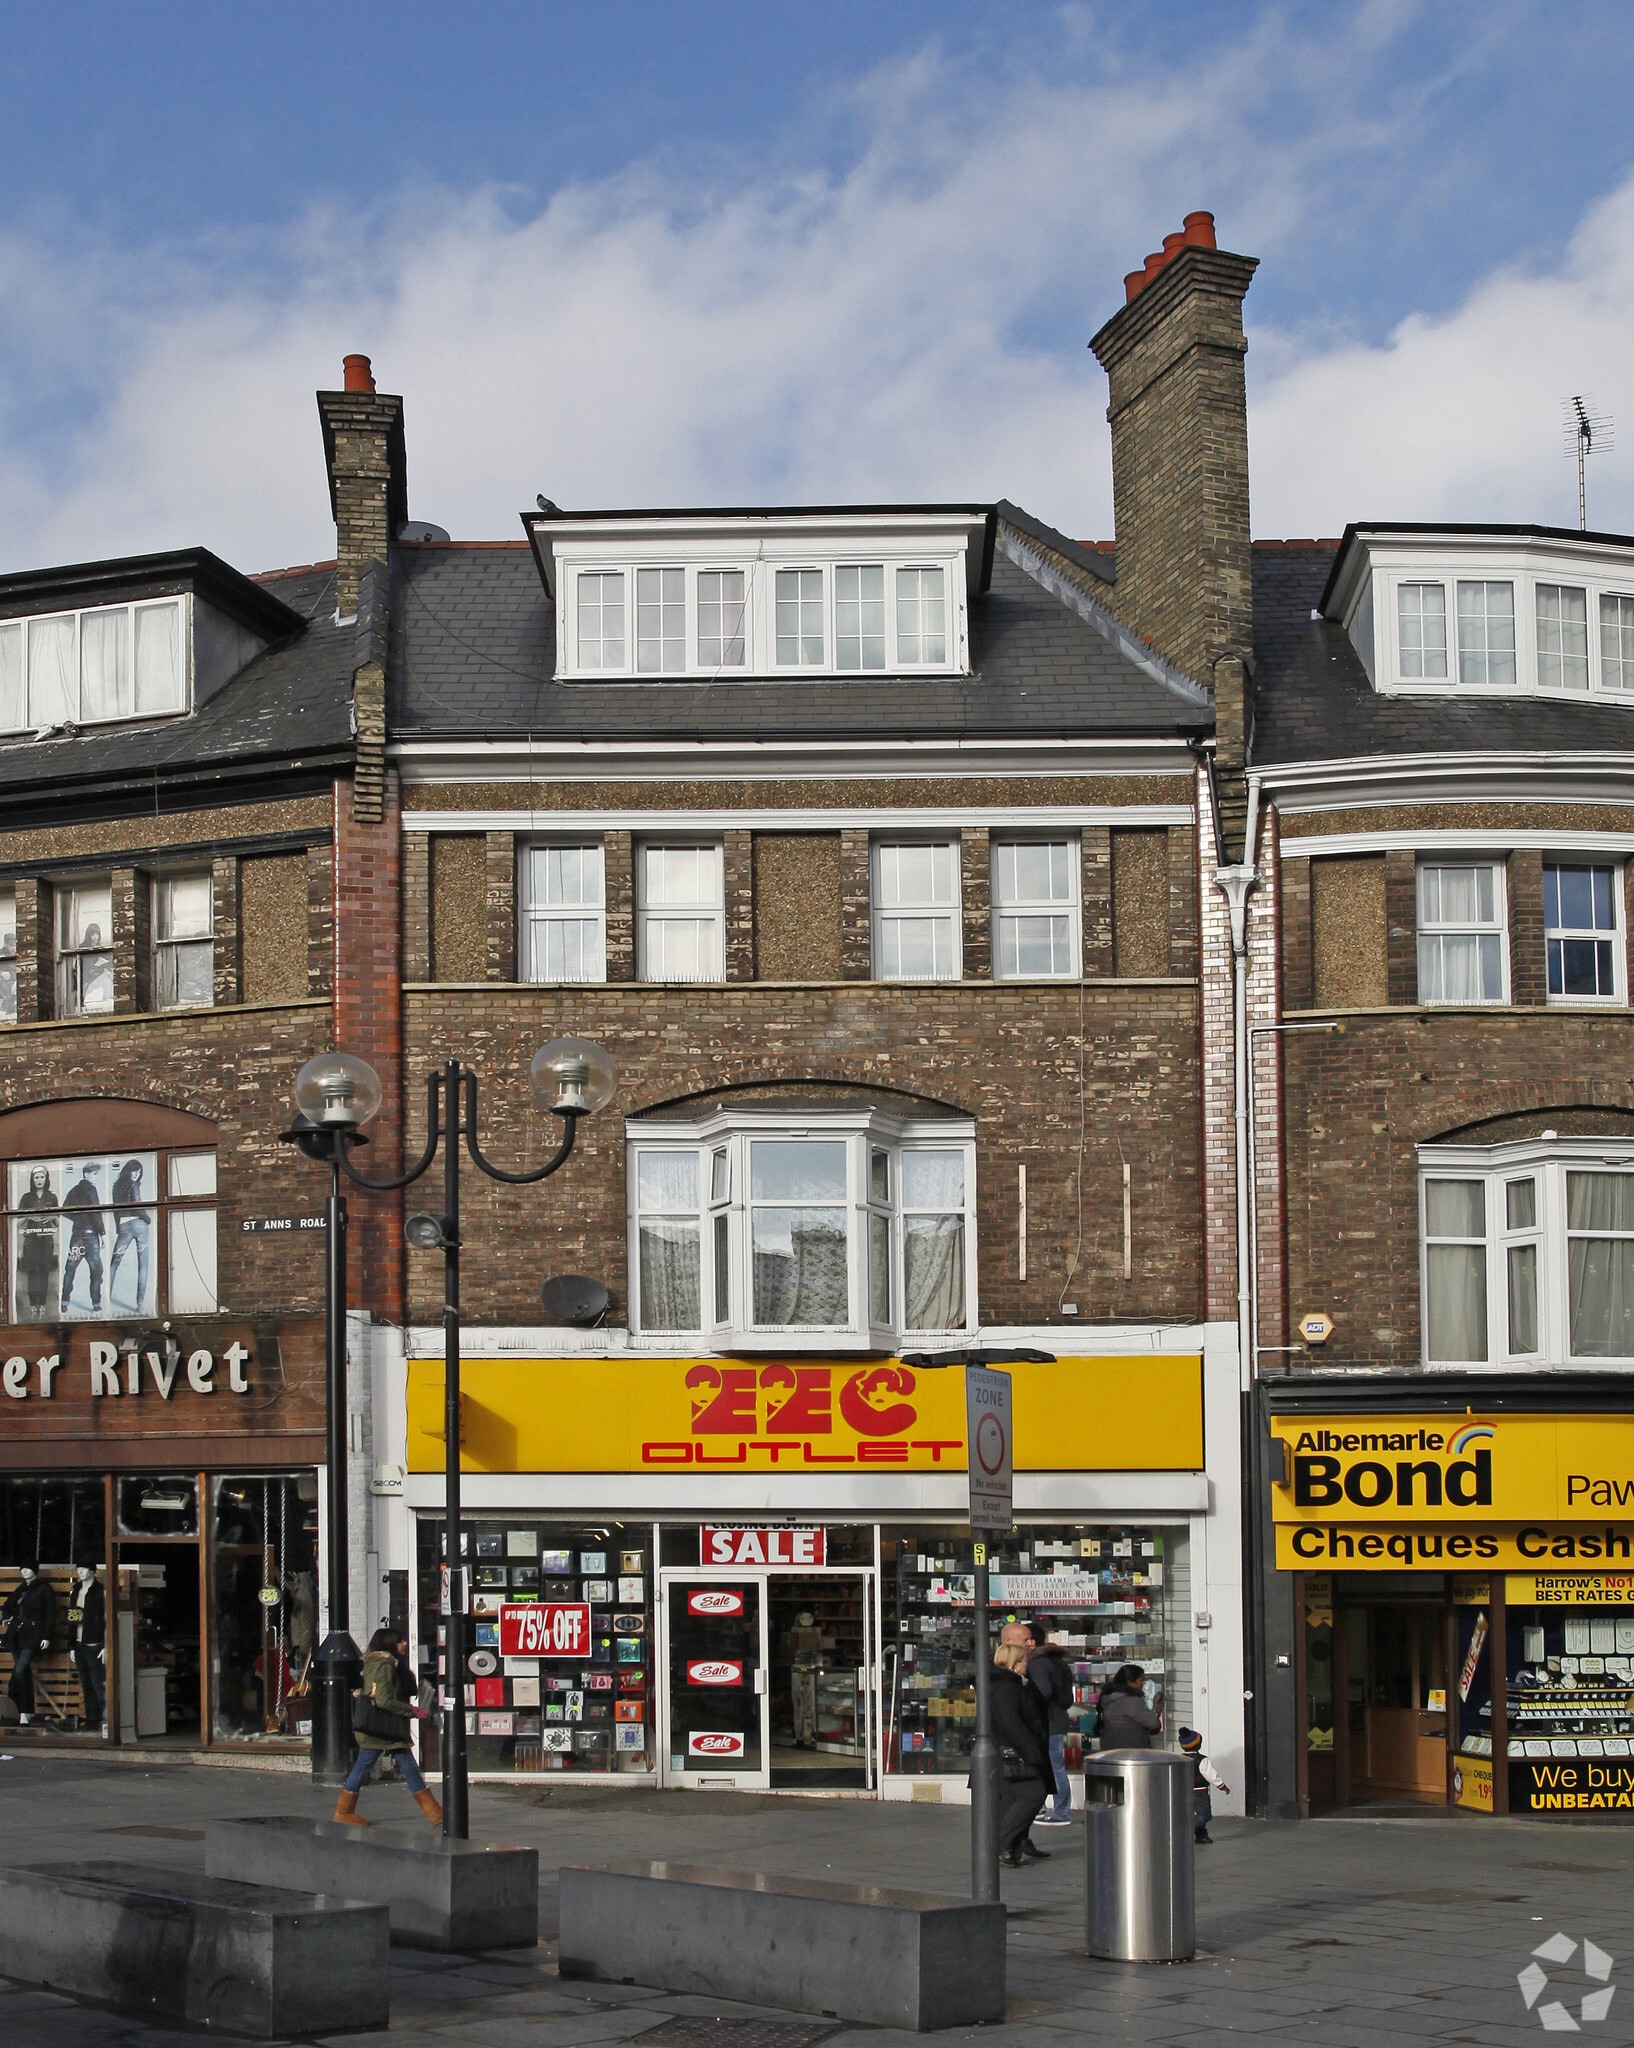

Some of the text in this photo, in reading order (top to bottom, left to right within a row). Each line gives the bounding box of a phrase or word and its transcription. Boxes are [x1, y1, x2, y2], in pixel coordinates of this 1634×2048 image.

[243, 1221, 257, 1231] ST
[264, 1219, 292, 1230] ANNS
[1307, 1323, 1324, 1333] ADT
[3, 1341, 249, 1400] er Rivet
[969, 1371, 1009, 1388] PEDESTRIAN
[975, 1387, 1004, 1407] ZONE
[1295, 1430, 1444, 1452] Albemarle
[642, 1441, 963, 1463] OUTLET
[976, 1478, 1007, 1491] No vehicles
[1294, 1450, 1492, 1507] Bond
[982, 1501, 1001, 1512] Except
[711, 1531, 815, 1564] SALE
[975, 1545, 984, 1554] S
[1291, 1527, 1634, 1565] Cheques Cash
[1535, 1576, 1633, 1588] Harrow's No1
[262, 1594, 278, 1602] OFF
[700, 1595, 730, 1607] Sale
[1008, 1590, 1095, 1599] WE ARE ONLINE NOW
[1535, 1590, 1571, 1601] BEST
[1576, 1590, 1622, 1601] RATES
[517, 1609, 551, 1651] 75%
[553, 1609, 583, 1651] OFF
[699, 1665, 729, 1676] Sale
[701, 1737, 731, 1748] Sale
[1531, 1763, 1634, 1792] We buy
[1530, 1792, 1634, 1809] UNBEATA
